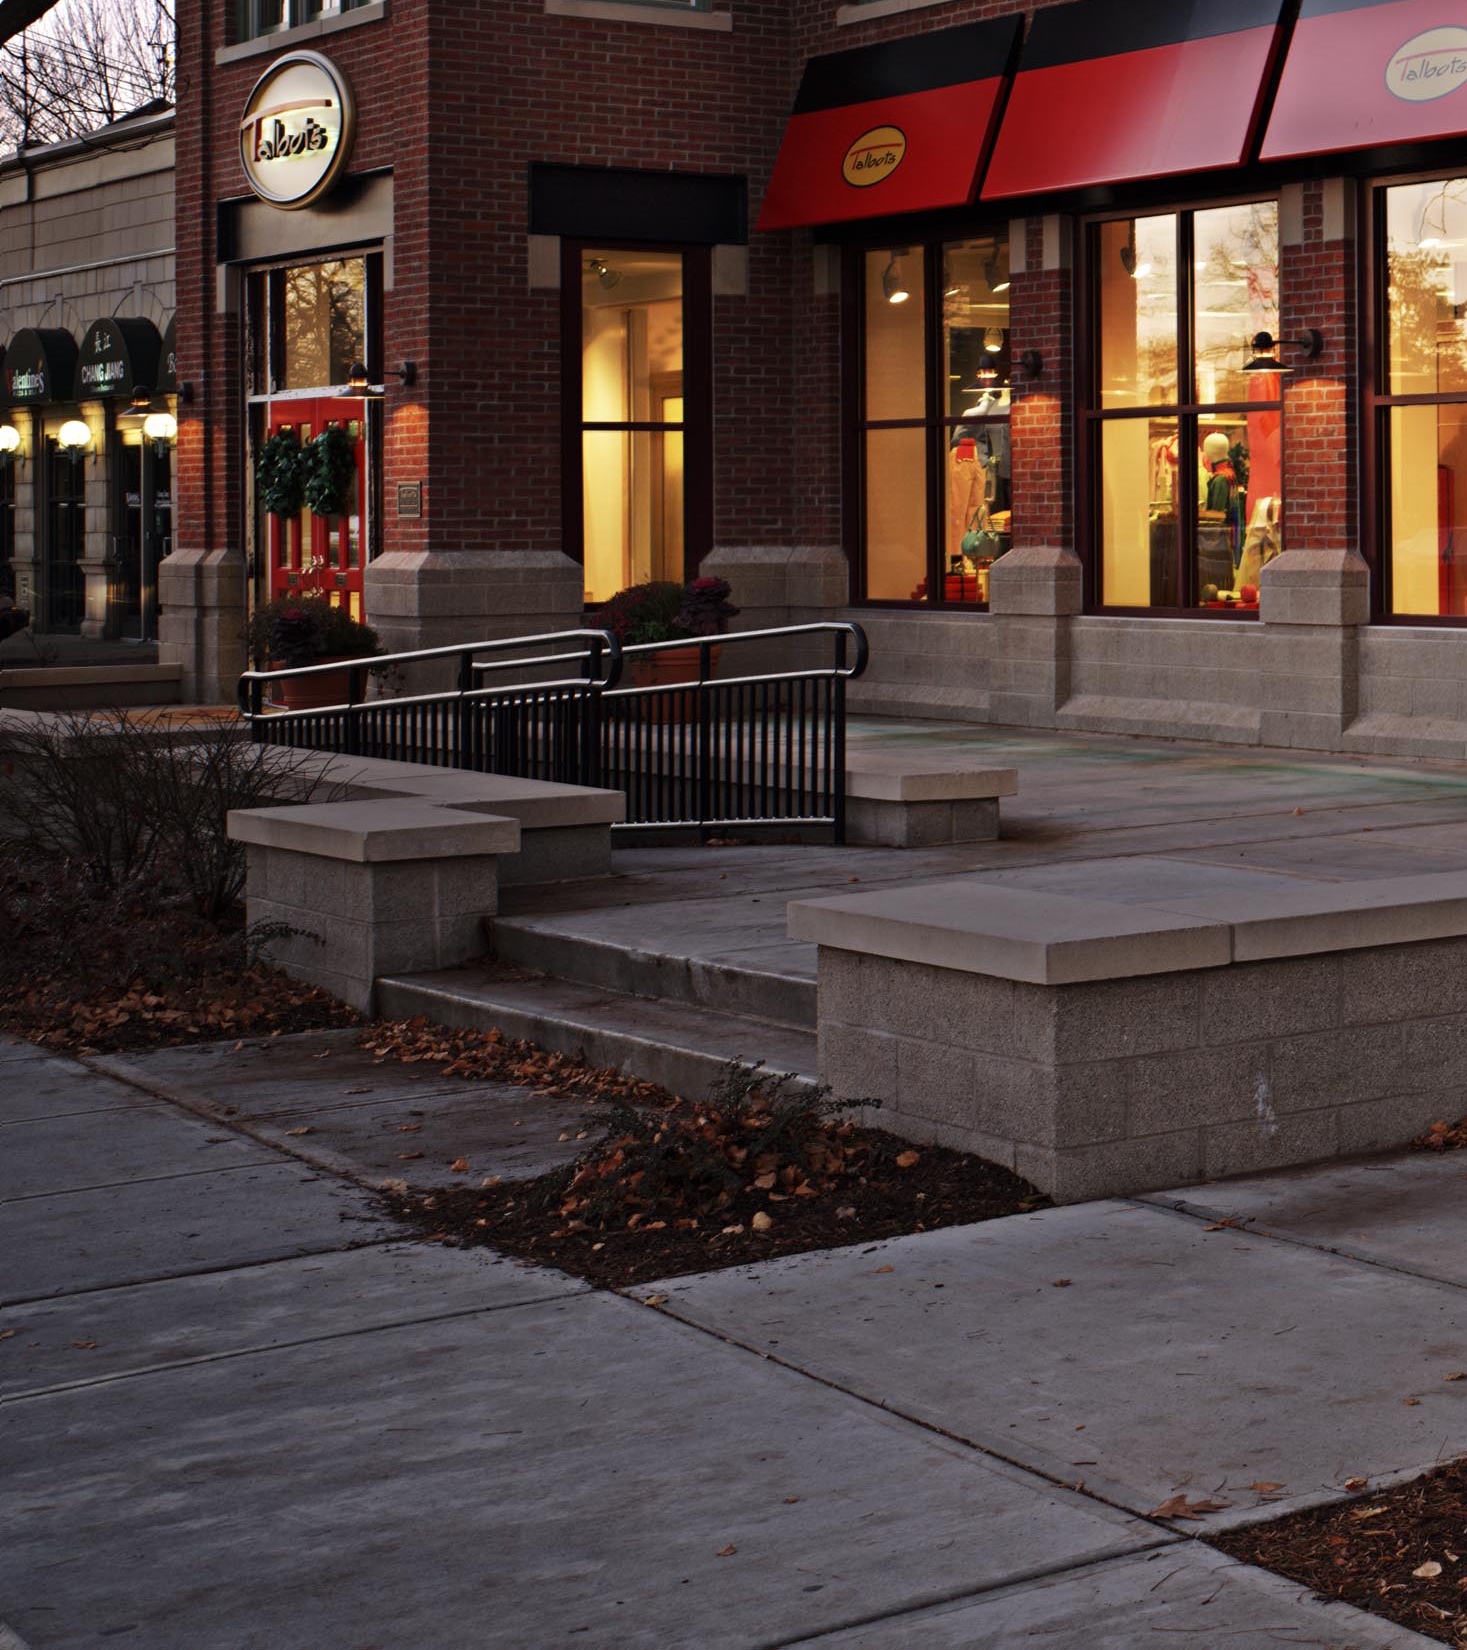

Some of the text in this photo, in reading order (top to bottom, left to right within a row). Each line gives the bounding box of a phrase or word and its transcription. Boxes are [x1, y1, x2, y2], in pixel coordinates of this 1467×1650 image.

[240, 99, 332, 162] Talbots
[850, 142, 903, 171] Talbots
[81, 363, 104, 384] CHANG
